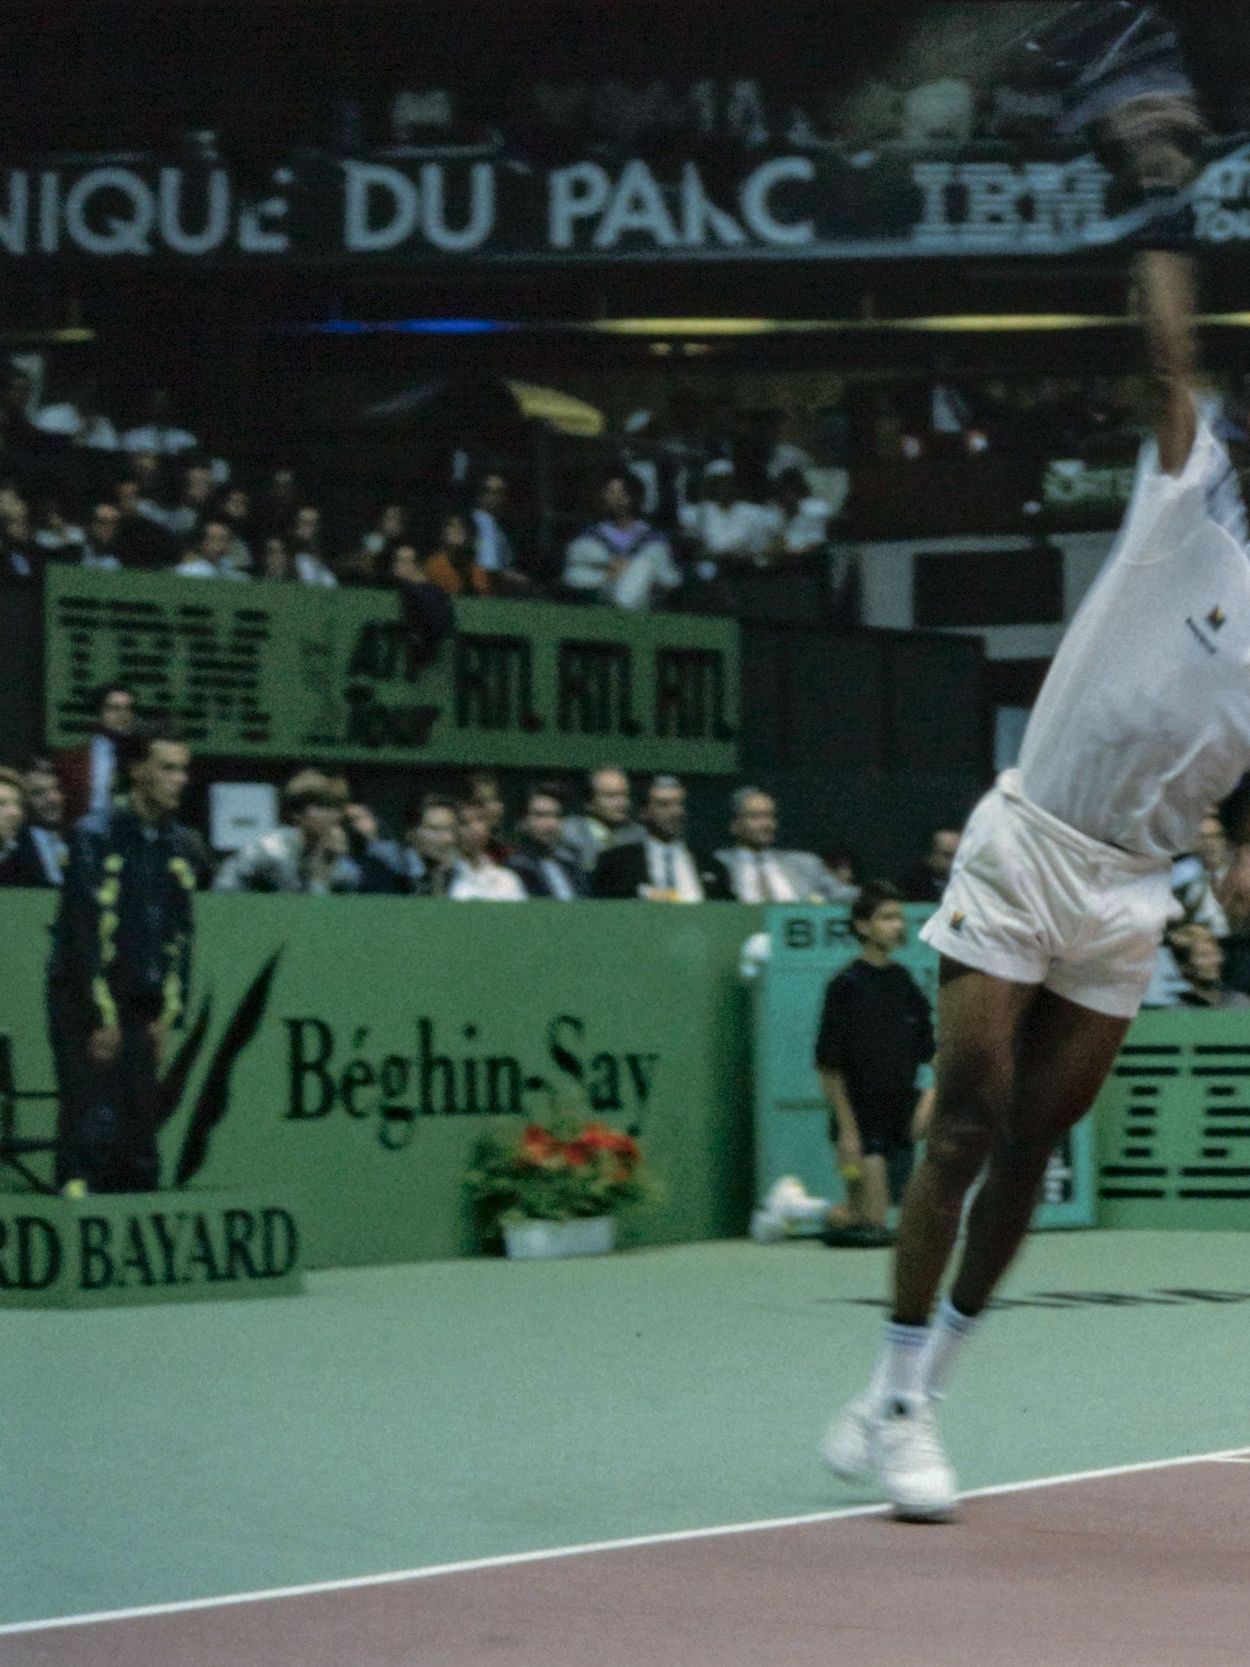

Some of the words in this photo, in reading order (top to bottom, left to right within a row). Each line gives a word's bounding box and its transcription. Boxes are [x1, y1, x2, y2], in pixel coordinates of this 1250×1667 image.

[342, 160, 497, 252] DU
[911, 160, 1112, 240] IBM
[57, 596, 270, 742] IBM
[281, 1013, 660, 1150] Béghin-Say
[79, 1206, 298, 1289] BAYARD
